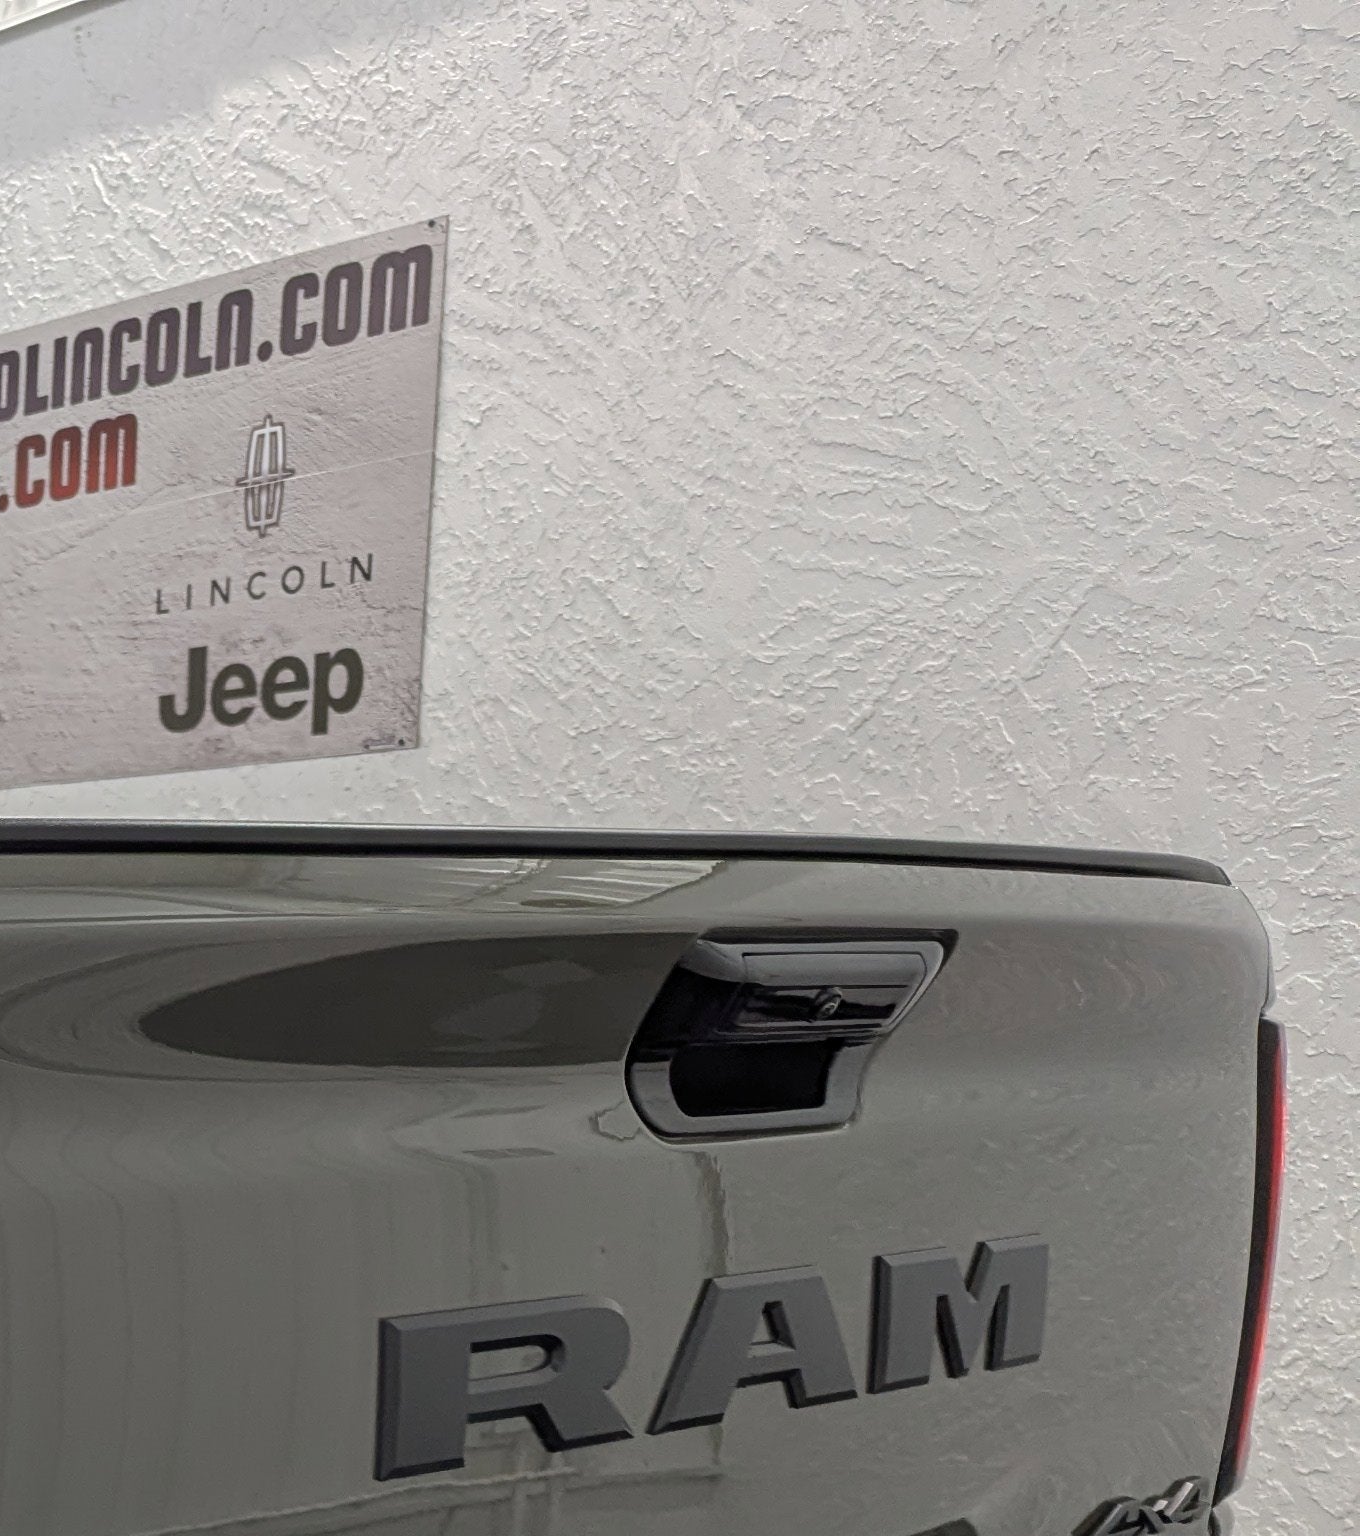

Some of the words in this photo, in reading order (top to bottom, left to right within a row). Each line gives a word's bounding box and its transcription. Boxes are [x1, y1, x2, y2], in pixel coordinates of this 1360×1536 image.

[154, 553, 374, 615] LINCOLN
[158, 645, 365, 736] Jeep
[374, 1232, 1051, 1482] RAM
